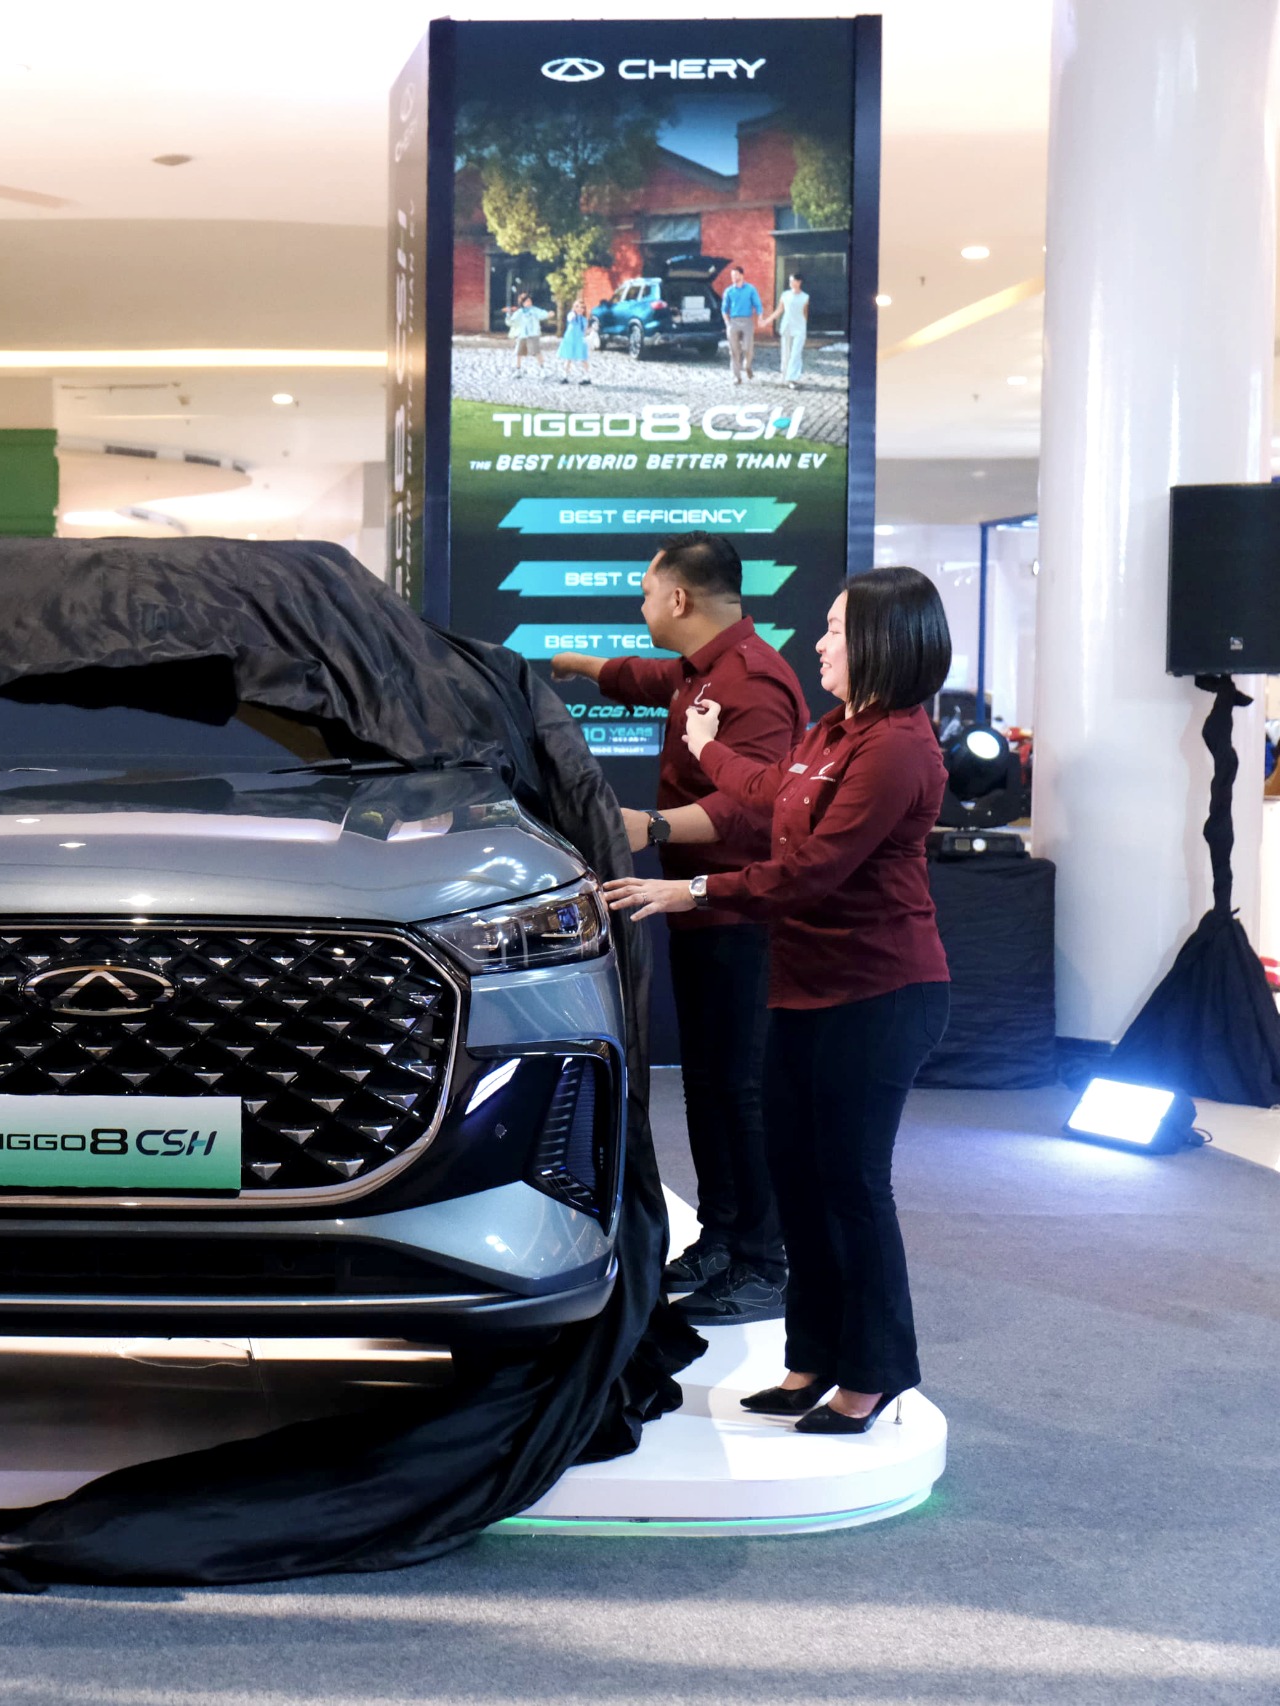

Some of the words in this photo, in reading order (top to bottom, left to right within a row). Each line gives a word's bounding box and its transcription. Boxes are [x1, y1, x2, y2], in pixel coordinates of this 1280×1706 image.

[618, 58, 766, 79] CHERY
[701, 405, 805, 440] CSH
[470, 460, 492, 470] THE
[496, 454, 553, 471] BEST
[557, 454, 637, 470] HYBRID
[646, 453, 727, 470] BETTER
[735, 453, 790, 469] THAN
[797, 453, 826, 469] EV
[559, 509, 617, 524] BEST
[622, 509, 747, 524] EFFICIENCY
[565, 572, 622, 587] BEST
[545, 634, 603, 649] BEST
[609, 727, 654, 737] YEARS
[135, 1129, 218, 1156] CSH
